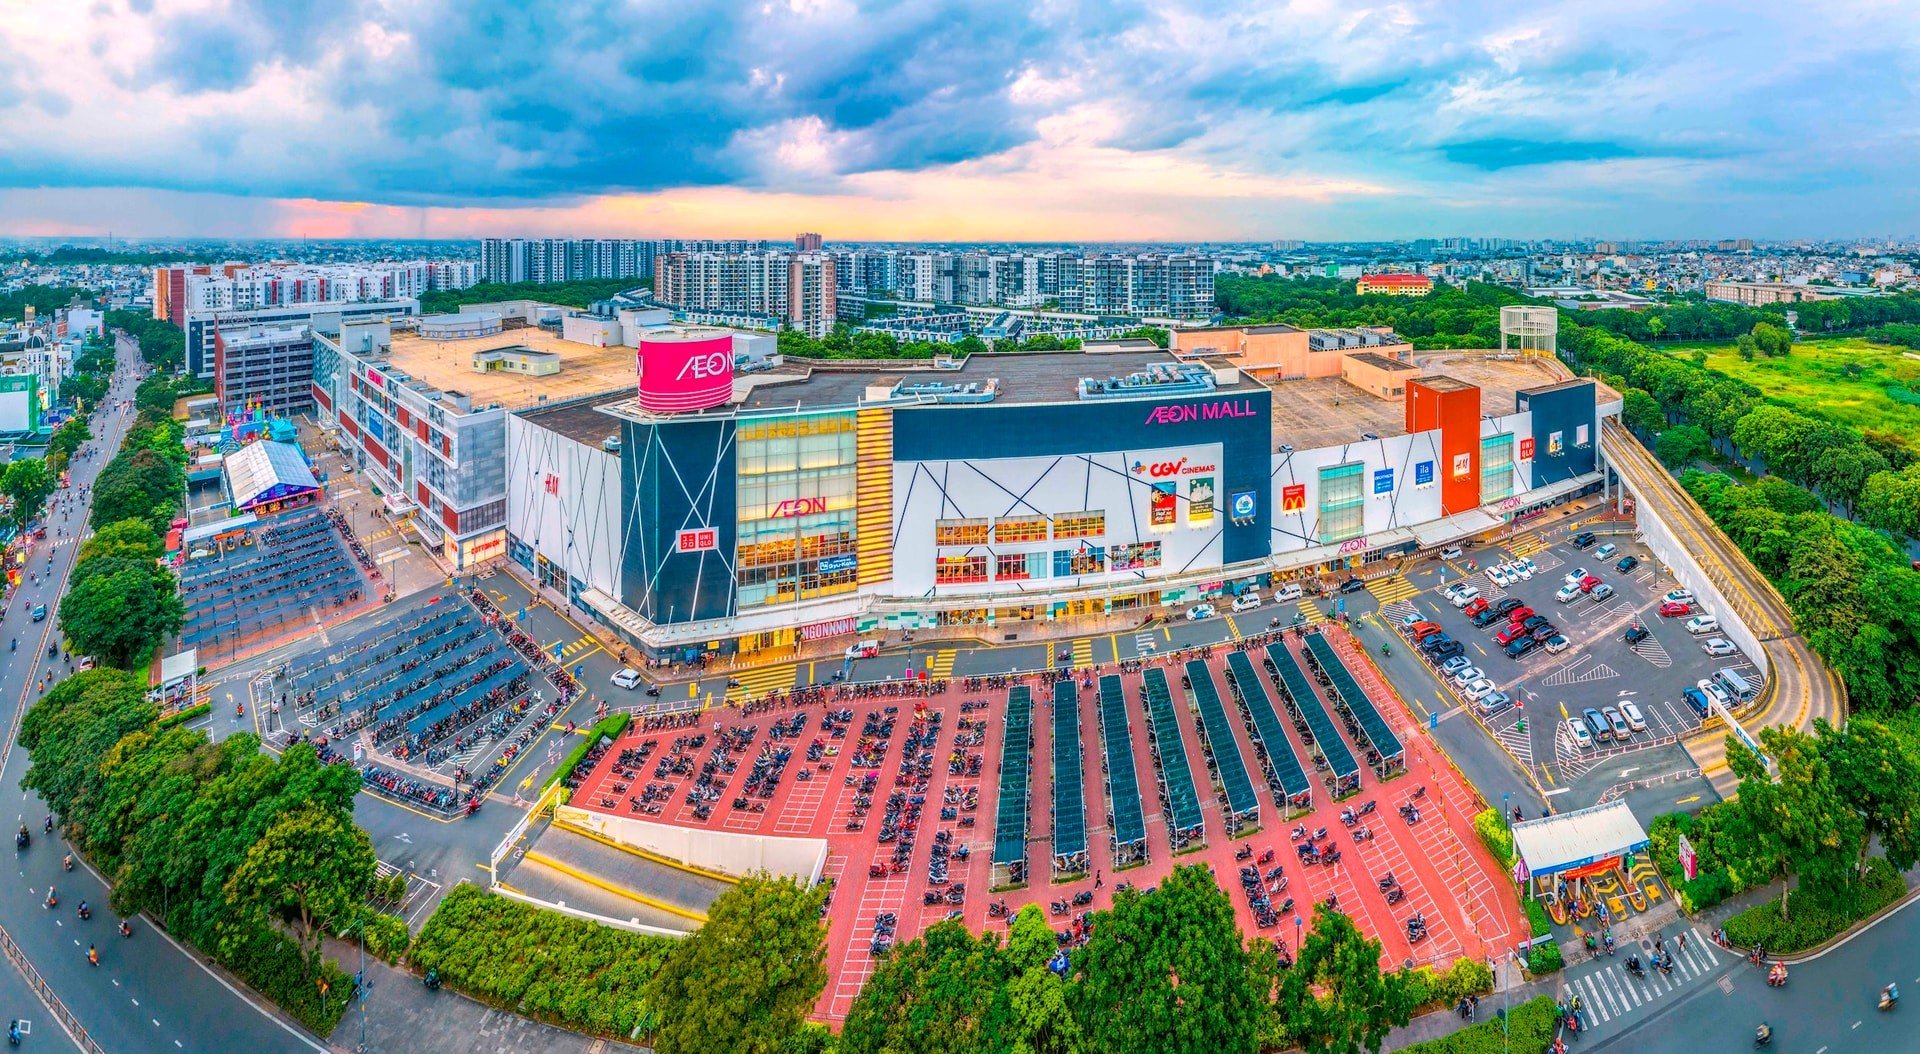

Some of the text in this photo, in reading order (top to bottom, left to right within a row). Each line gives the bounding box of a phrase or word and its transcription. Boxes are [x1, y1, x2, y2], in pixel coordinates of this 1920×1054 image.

[1202, 400, 1256, 420] MALL
[1150, 460, 1215, 477] CGV CINEMAS
[1420, 465, 1429, 474] ila
[699, 533, 711, 541] UNI
